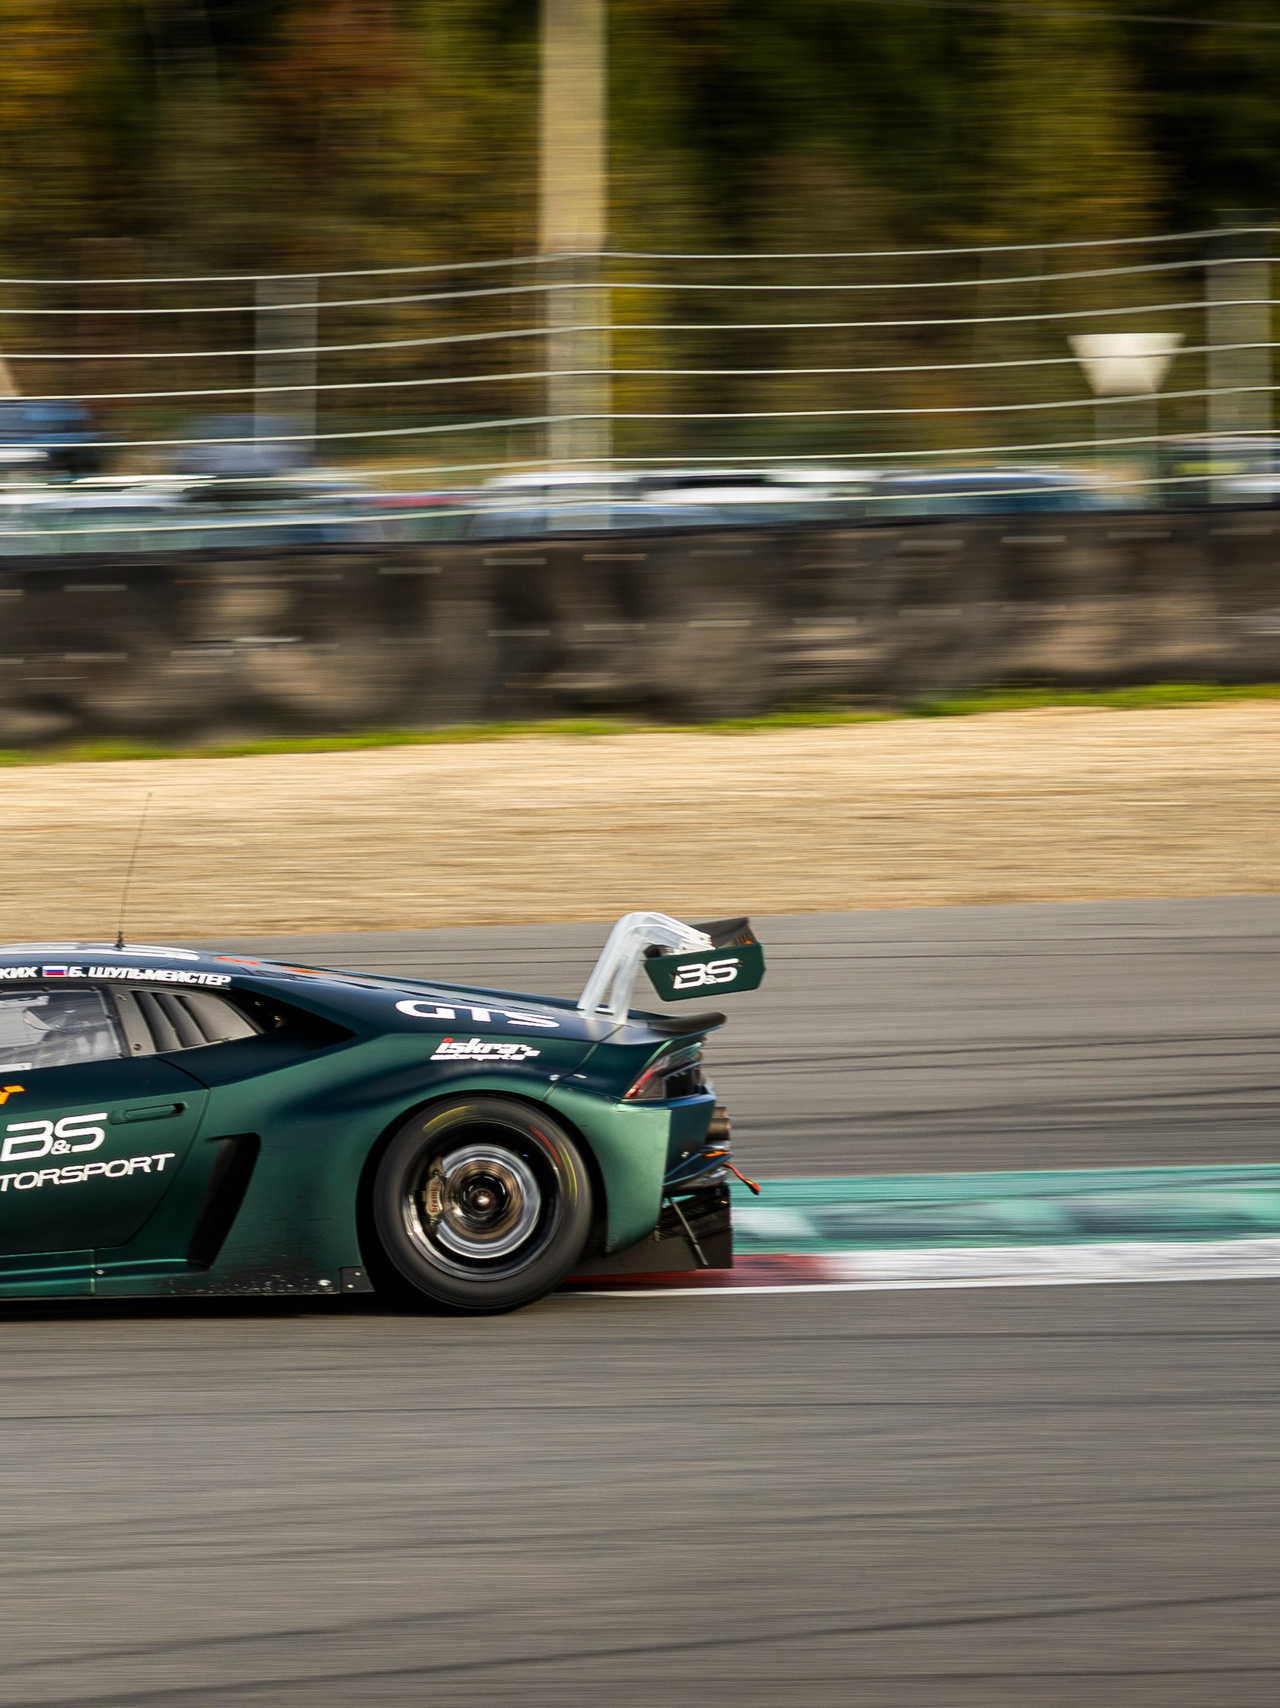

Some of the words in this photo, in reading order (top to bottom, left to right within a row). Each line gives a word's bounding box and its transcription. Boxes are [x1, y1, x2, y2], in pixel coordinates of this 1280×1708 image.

[88, 966, 232, 987] ШУЛЬМЕЙСТЕР
[395, 999, 561, 1029] GTS
[0, 1112, 109, 1163] B&S
